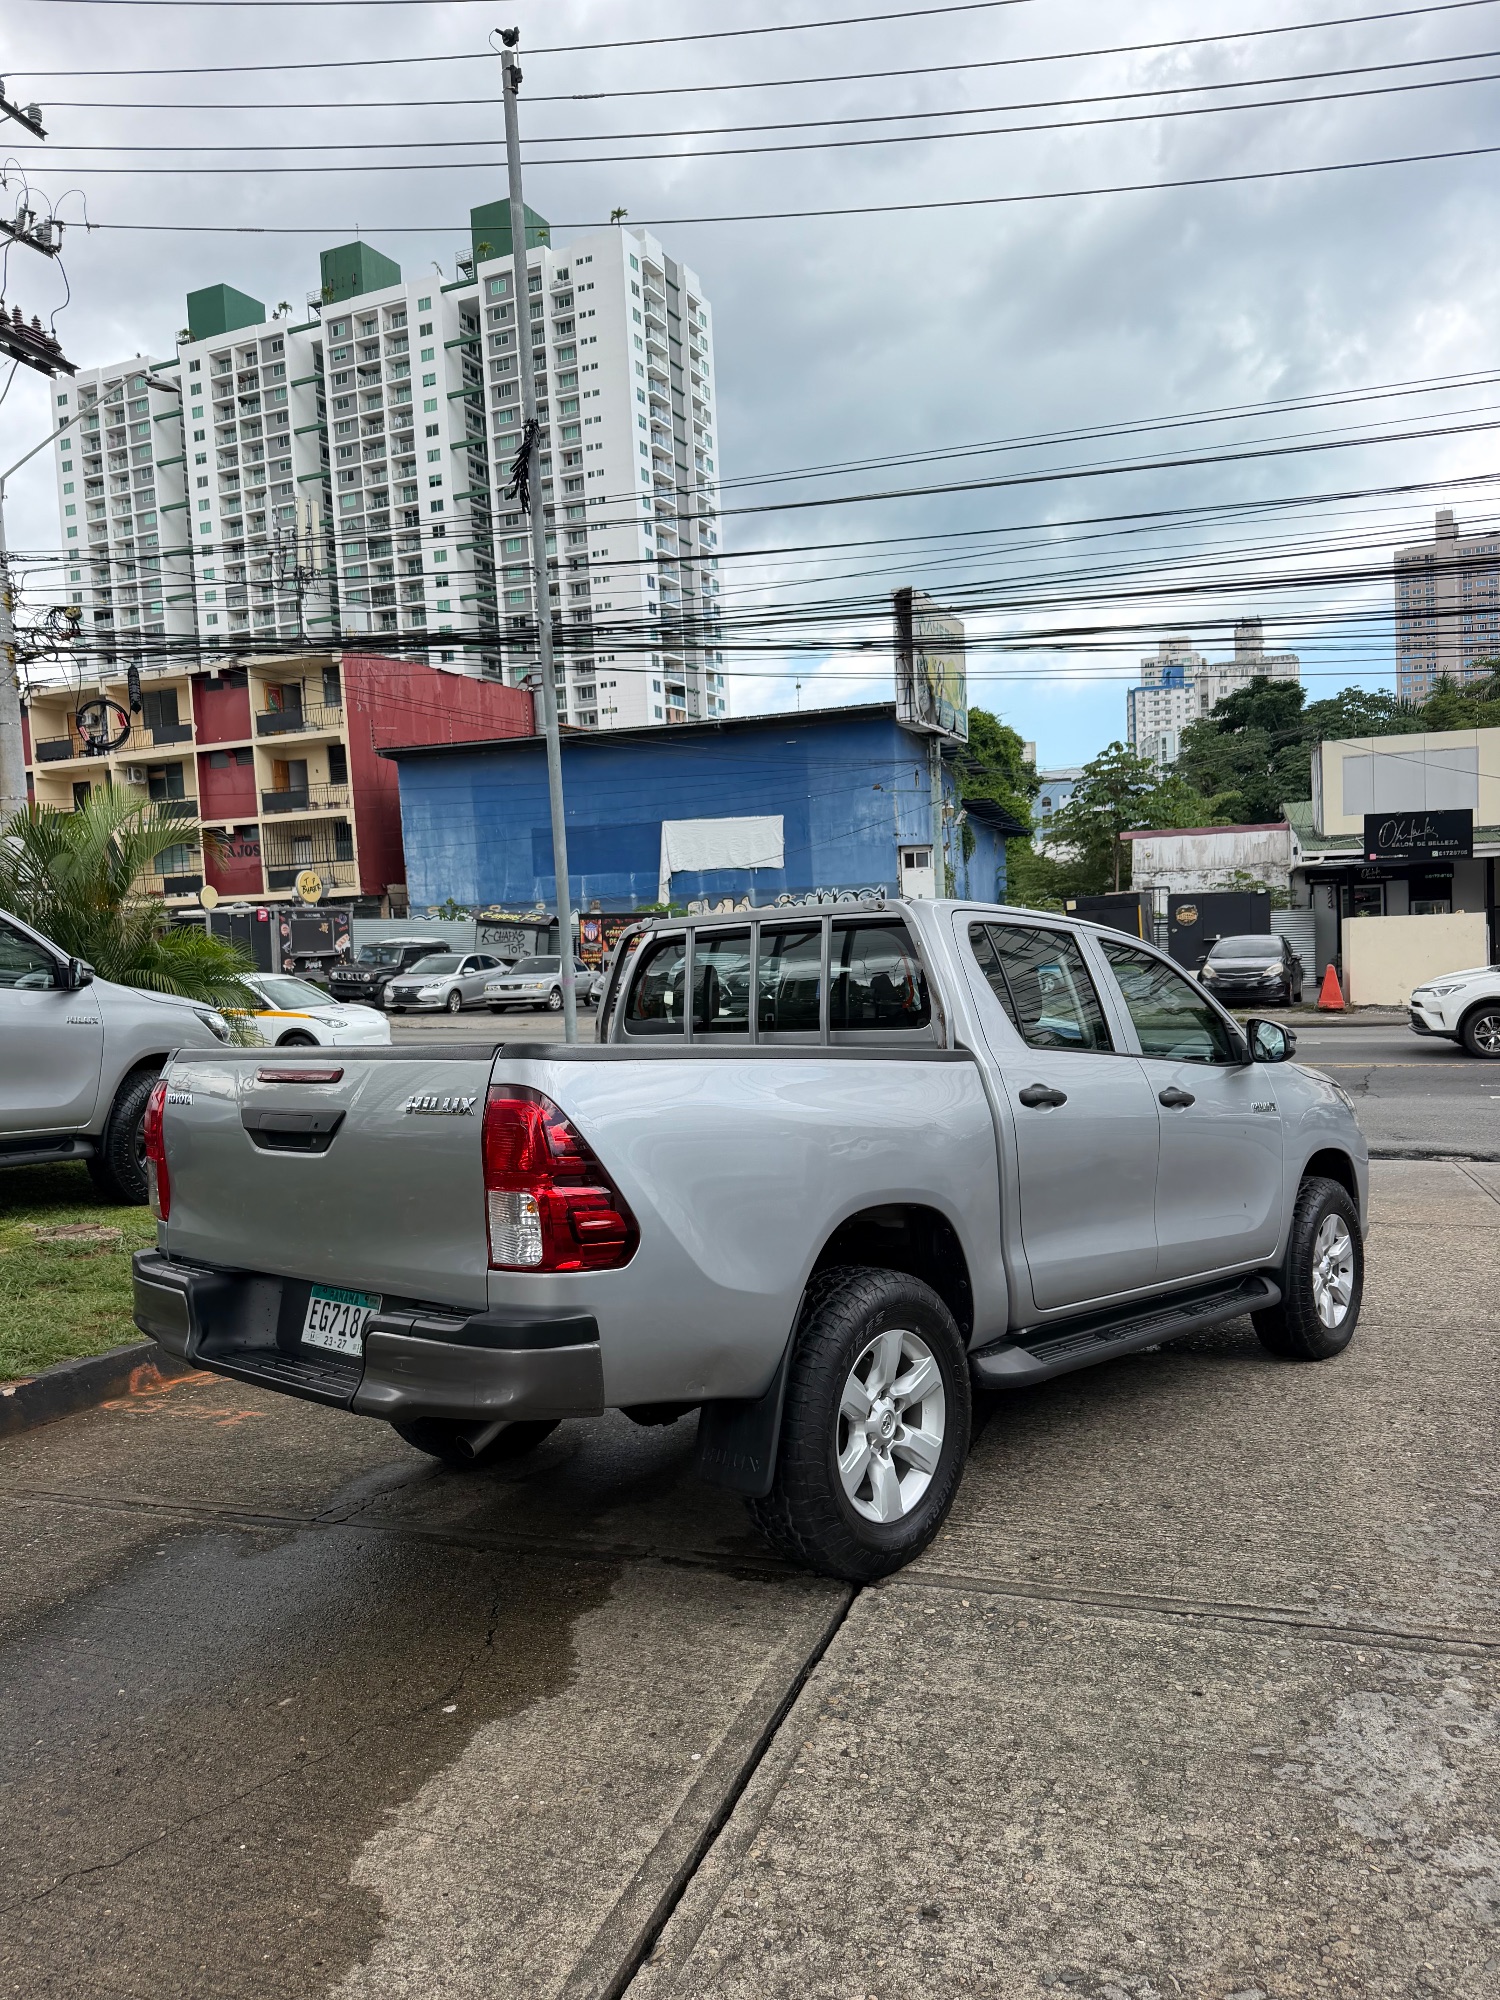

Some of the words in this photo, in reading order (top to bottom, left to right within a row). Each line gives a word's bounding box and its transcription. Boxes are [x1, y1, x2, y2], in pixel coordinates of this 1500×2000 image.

[1379, 820, 1407, 848] Oh
[223, 843, 261, 858] AJOS
[1392, 840, 1414, 848] SALON
[482, 928, 525, 943] K-CHAPAS
[504, 943, 524, 955] TOP
[168, 1092, 194, 1105] TOYOTA
[405, 1096, 477, 1116] HILUX
